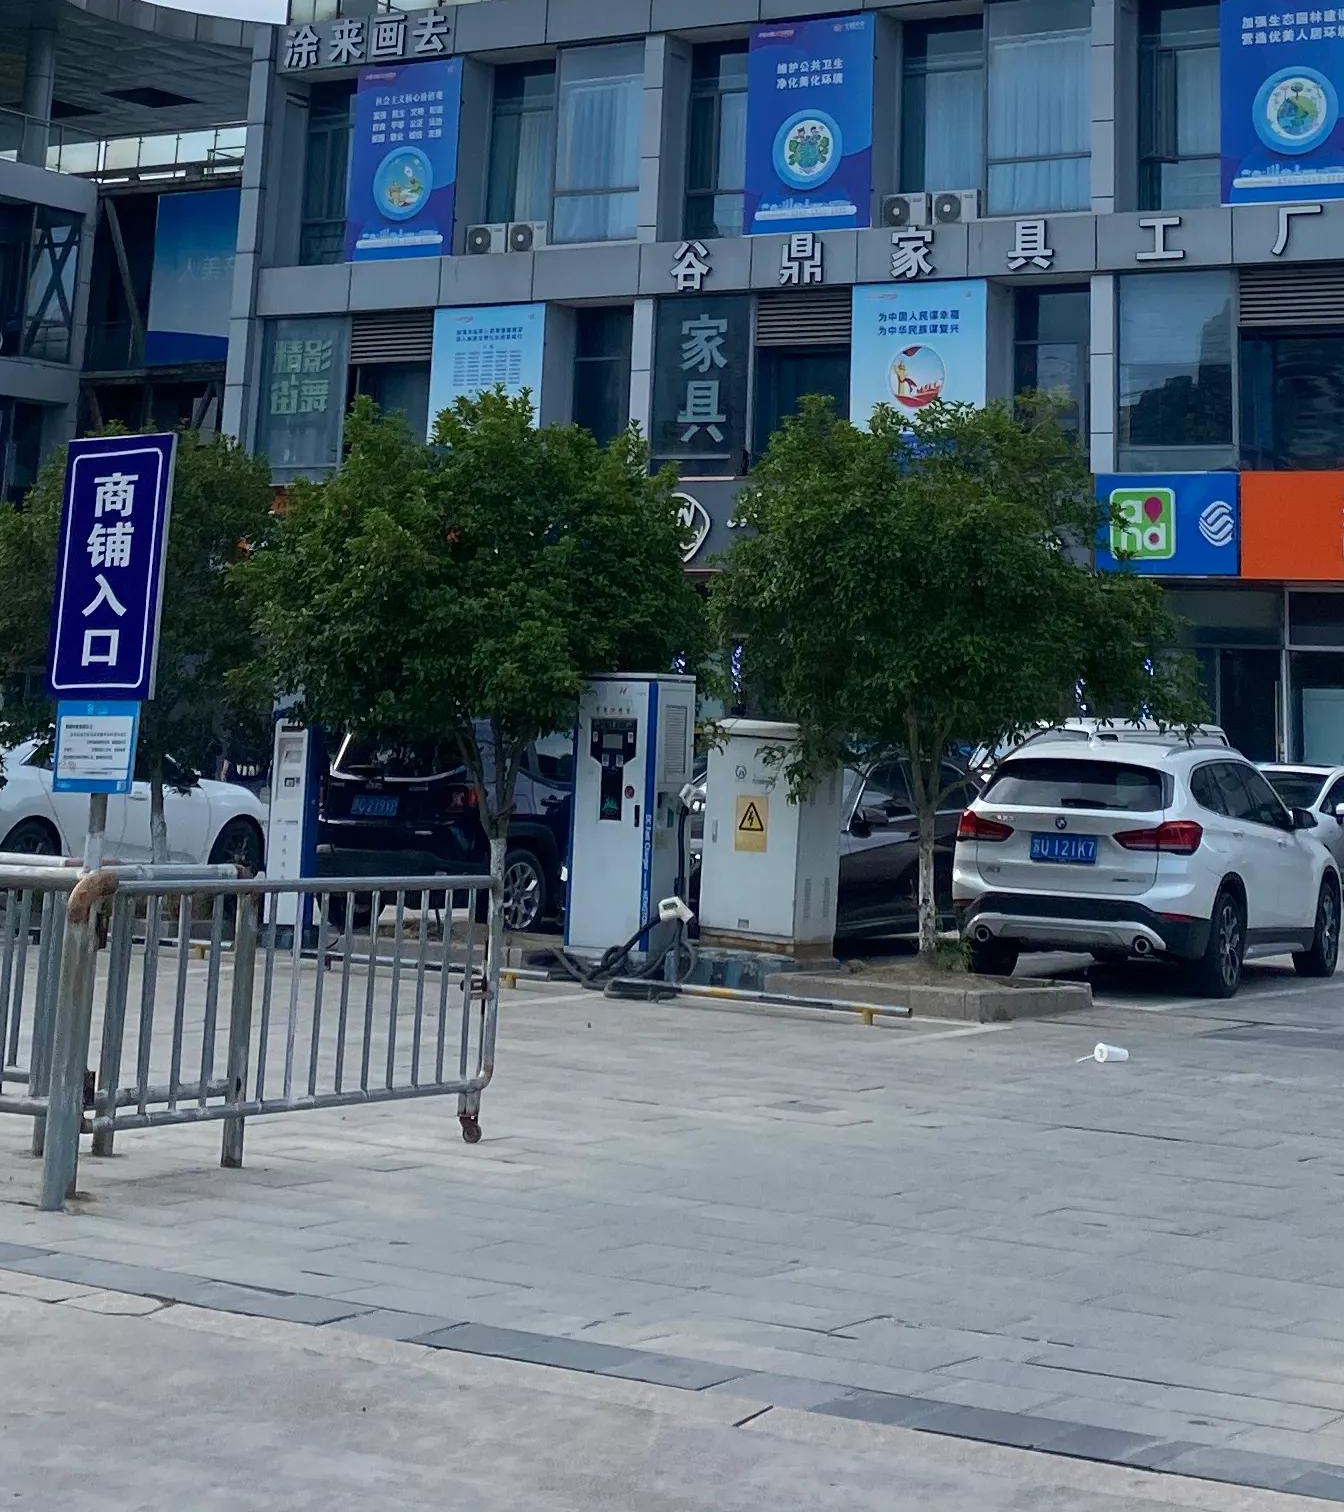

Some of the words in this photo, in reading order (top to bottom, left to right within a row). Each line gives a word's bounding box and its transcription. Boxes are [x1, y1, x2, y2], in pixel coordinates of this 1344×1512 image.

[284, 10, 449, 68] 涂来画去
[878, 309, 960, 322] 为中国人民谋幸福
[878, 324, 959, 336] 为中华民族谋复兴
[676, 313, 729, 444] 家具
[81, 472, 139, 667] 商铺入口
